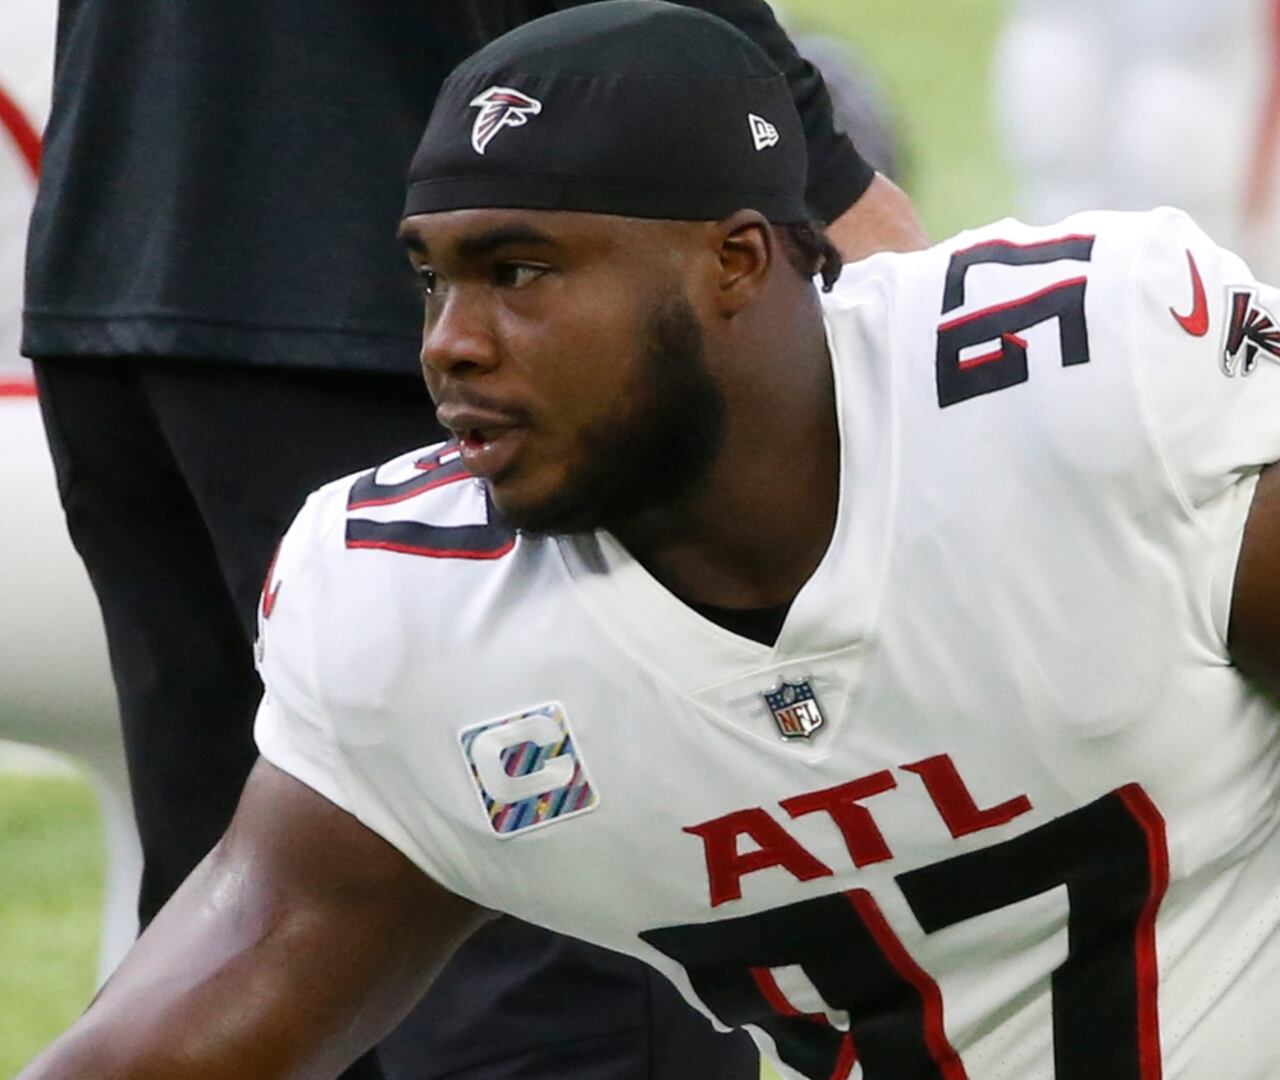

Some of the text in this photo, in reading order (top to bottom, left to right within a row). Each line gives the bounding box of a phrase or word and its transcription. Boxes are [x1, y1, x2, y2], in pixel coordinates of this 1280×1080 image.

[935, 234, 1096, 409] 97
[471, 715, 574, 803] C
[682, 753, 1033, 908] ATL
